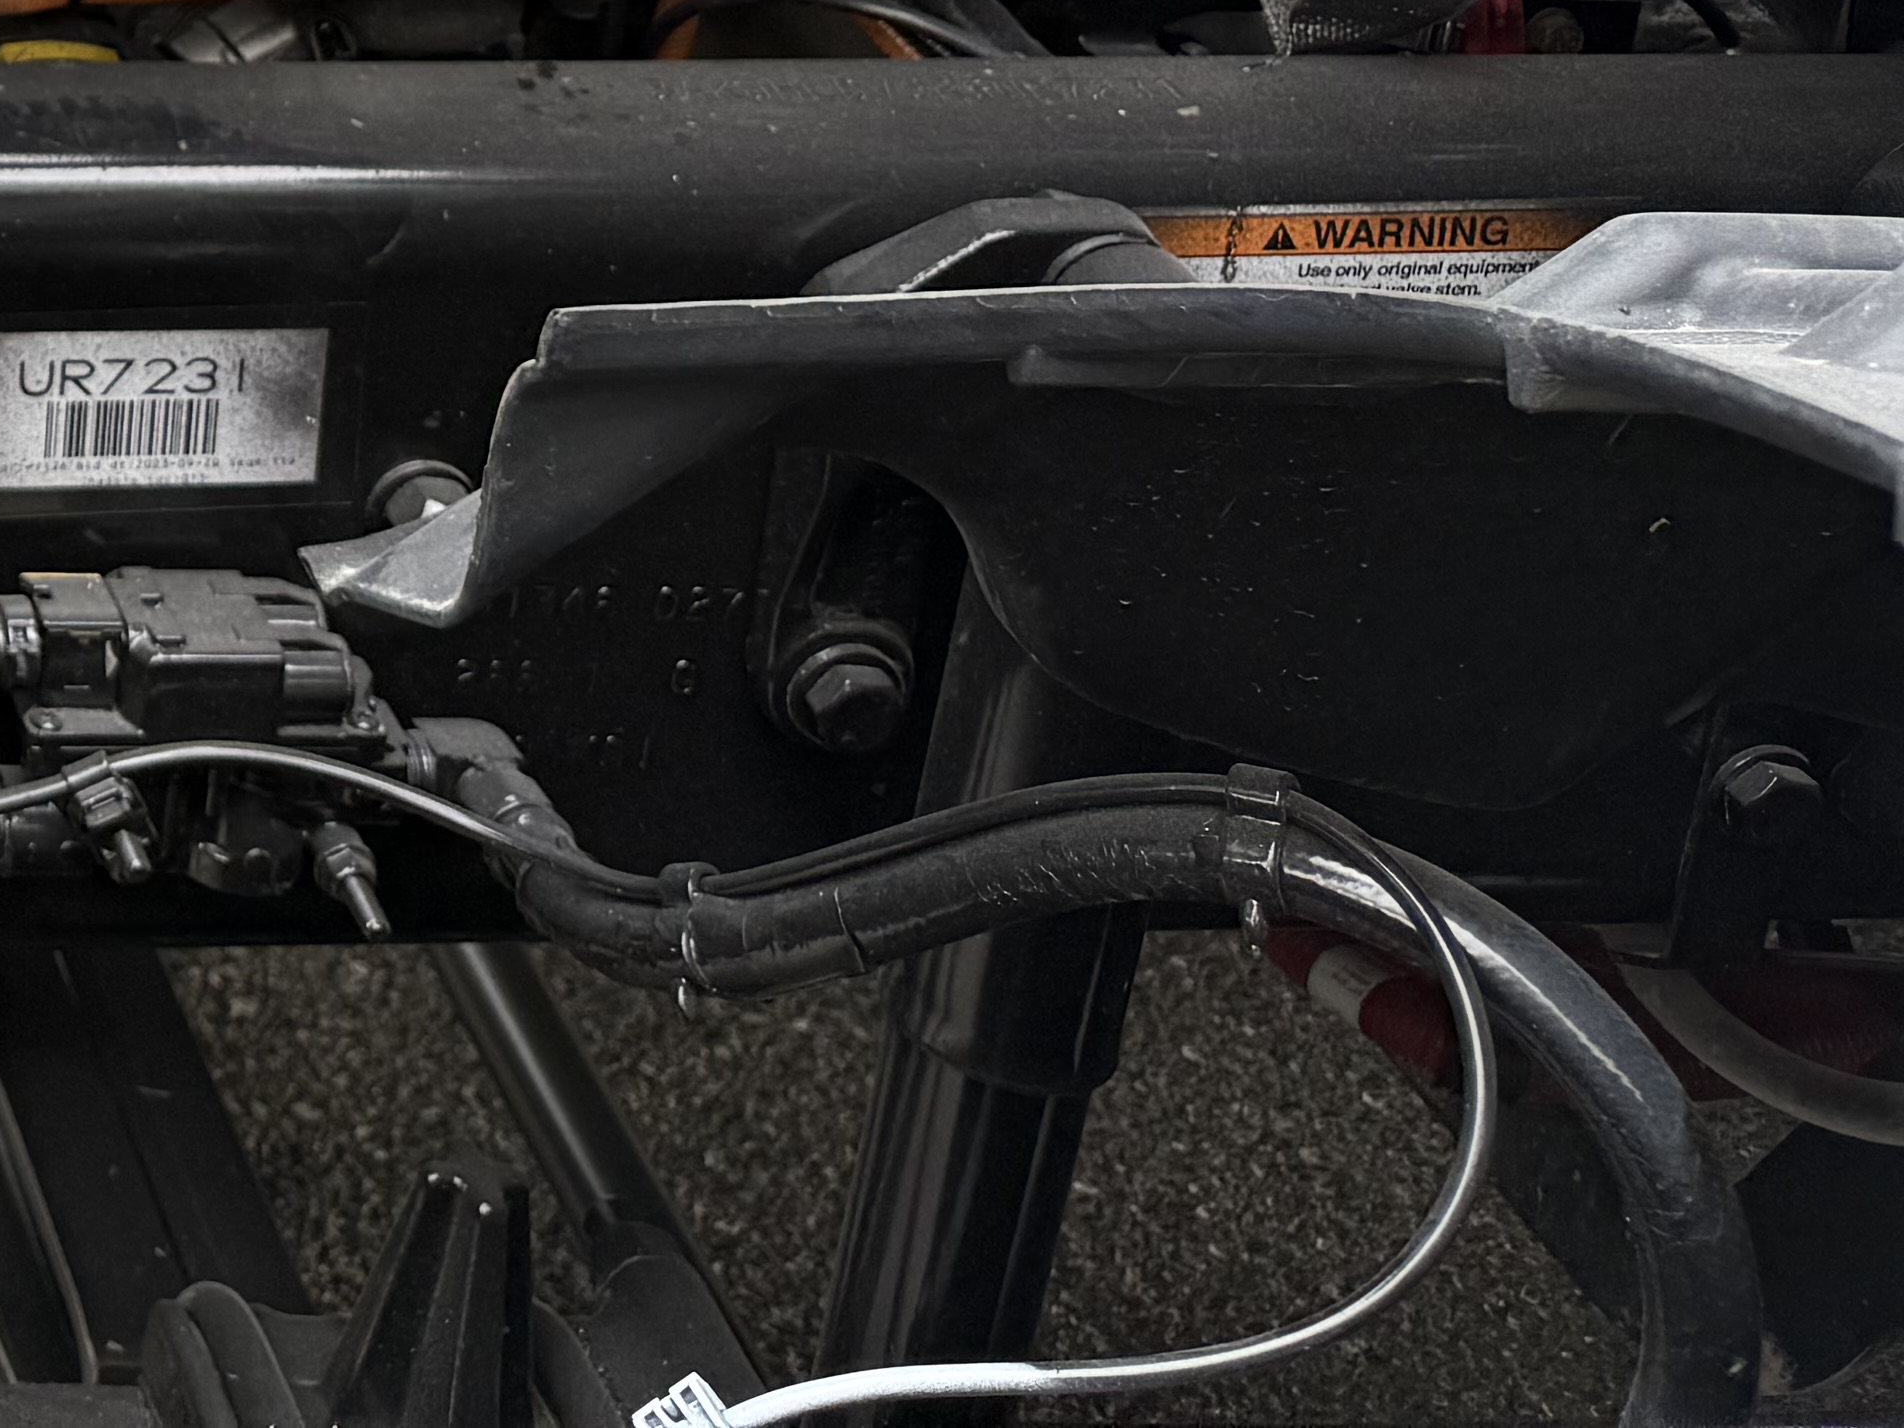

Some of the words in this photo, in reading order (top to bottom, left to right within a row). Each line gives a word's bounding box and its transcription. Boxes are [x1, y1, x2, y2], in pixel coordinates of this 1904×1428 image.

[1313, 215, 1510, 249] WARNING
[1297, 263, 1331, 278] Use
[1335, 262, 1372, 280] only
[1377, 260, 1442, 278] original
[1446, 259, 1541, 279] equipment
[18, 356, 245, 397] UR7231
